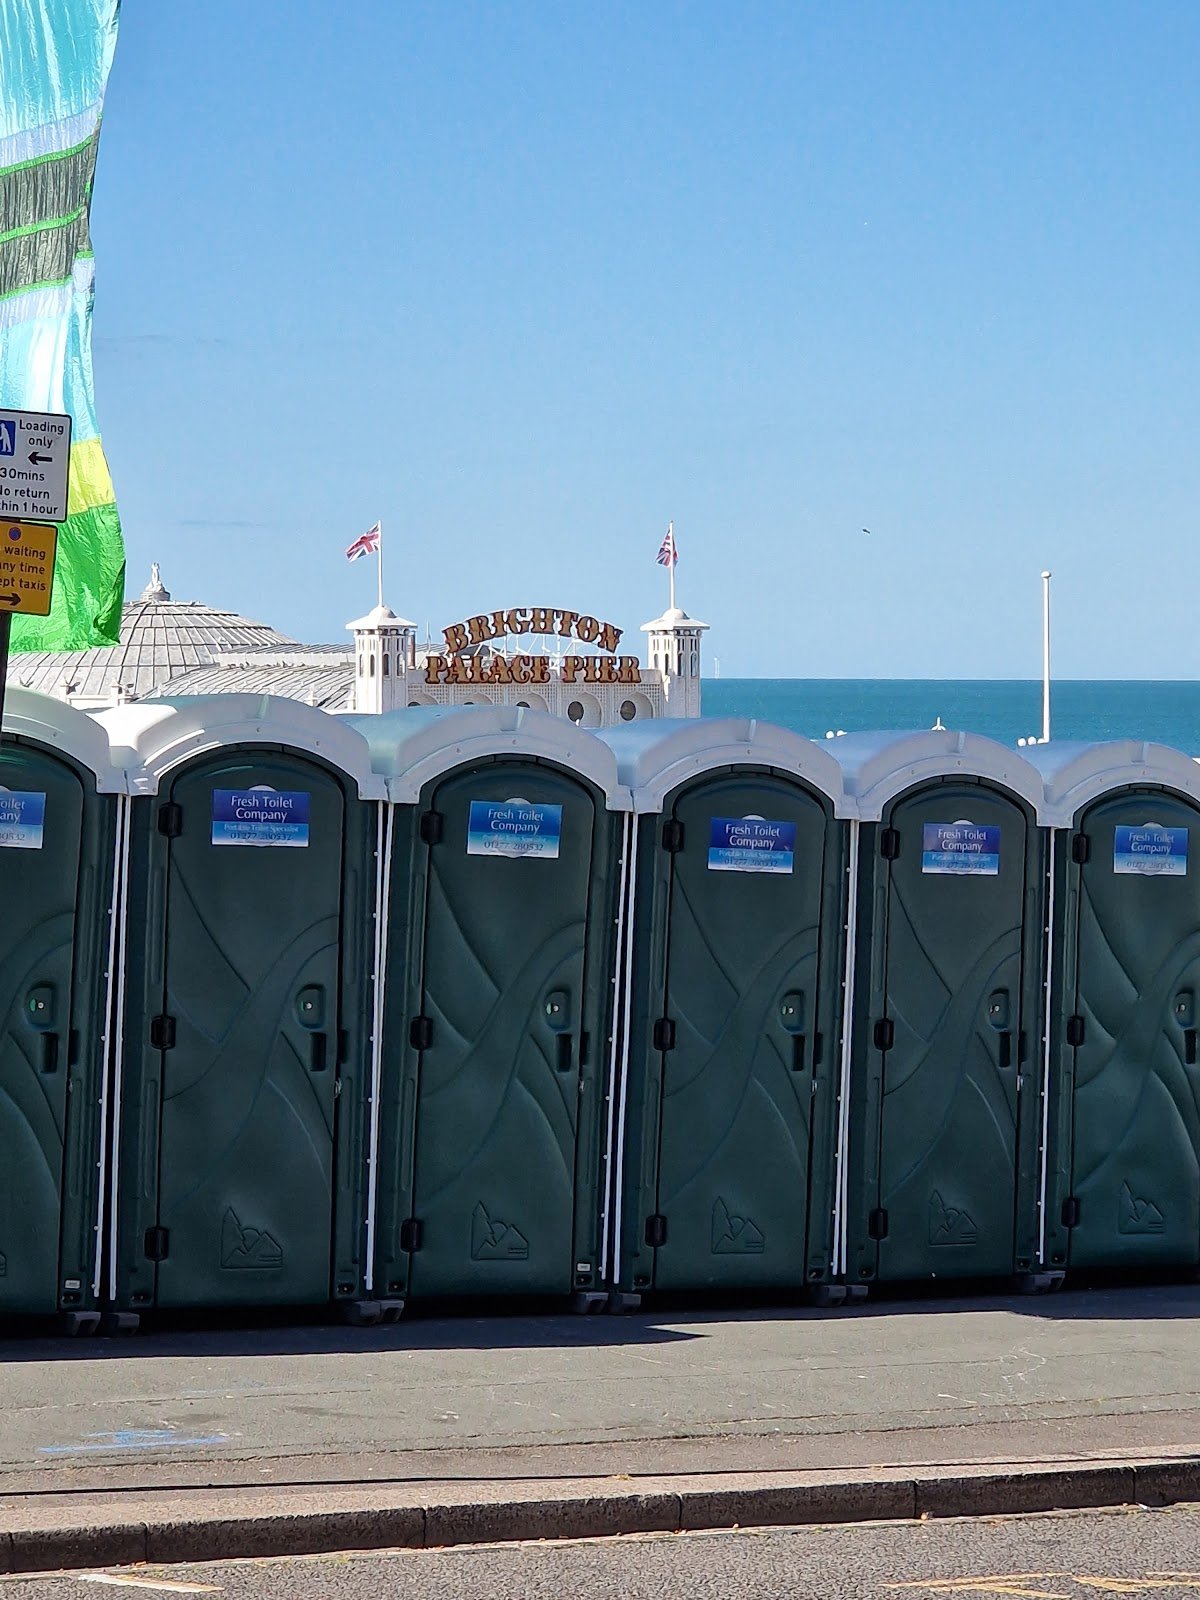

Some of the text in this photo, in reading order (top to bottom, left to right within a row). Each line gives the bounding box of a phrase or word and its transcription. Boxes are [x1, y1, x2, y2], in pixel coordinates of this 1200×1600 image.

[20, 419, 64, 435] Loading
[28, 436, 53, 449] only
[0, 467, 45, 481] 30mins
[14, 488, 50, 499] return
[23, 502, 28, 512] 1
[31, 503, 58, 514] hour
[4, 546, 46, 560] waiting
[20, 562, 46, 574] time
[19, 578, 46, 591] taxis
[441, 607, 624, 654] BRIGHTON
[425, 655, 642, 684] PALACE PIER
[231, 795, 293, 808] Fresh Toilet
[235, 807, 287, 823] Company
[488, 808, 544, 821] Fresh Toilet
[490, 820, 540, 836] Company
[725, 823, 780, 837] Fresh Toilet
[937, 828, 987, 840] Fresh Toilet
[729, 835, 775, 851] Company
[1128, 832, 1174, 843] Fresh Toilet
[941, 840, 983, 854] Company
[1131, 842, 1172, 856] Company
